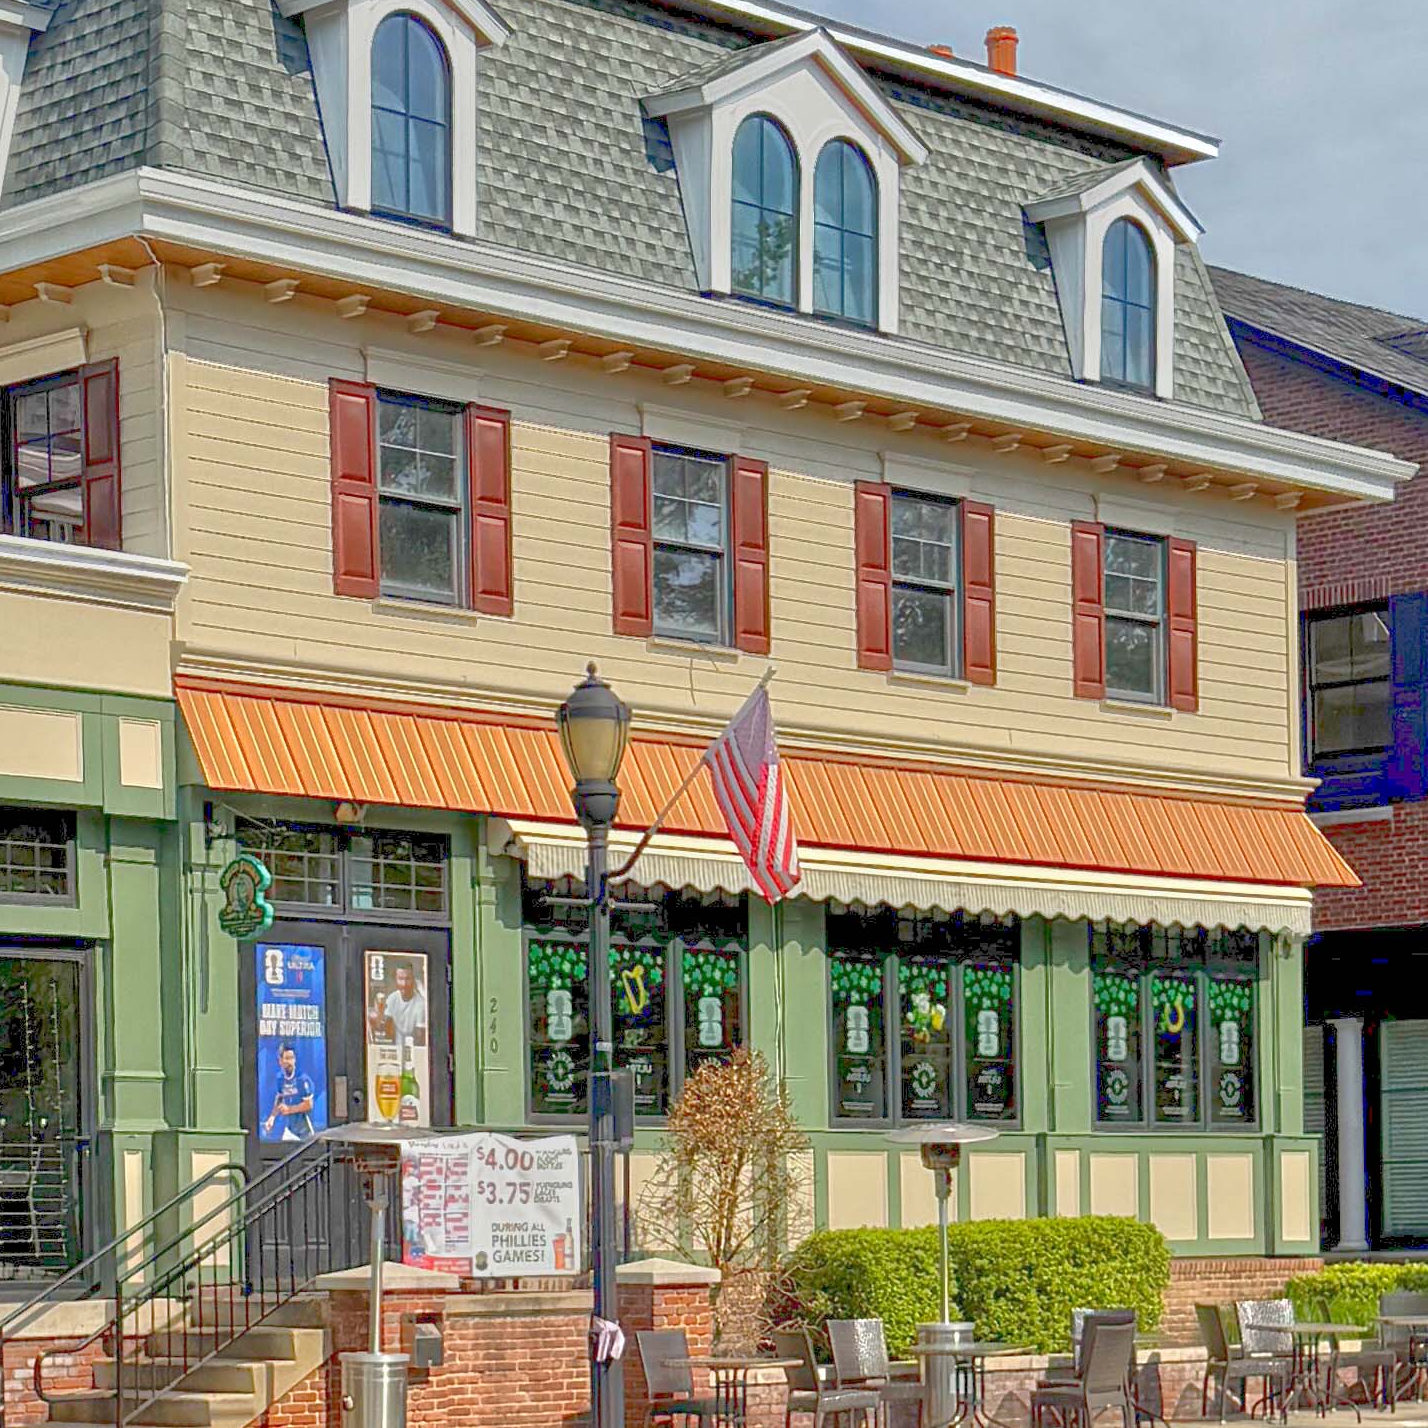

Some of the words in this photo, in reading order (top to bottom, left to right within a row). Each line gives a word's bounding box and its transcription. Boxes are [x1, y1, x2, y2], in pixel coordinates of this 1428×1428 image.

[476, 1146, 534, 1172] $4.00
[477, 1180, 532, 1205] $3.75
[491, 1222, 529, 1233] DURING
[531, 1222, 546, 1233] ALL
[491, 1234, 547, 1248] PHILLIES
[492, 1249, 545, 1263] GAMES!
